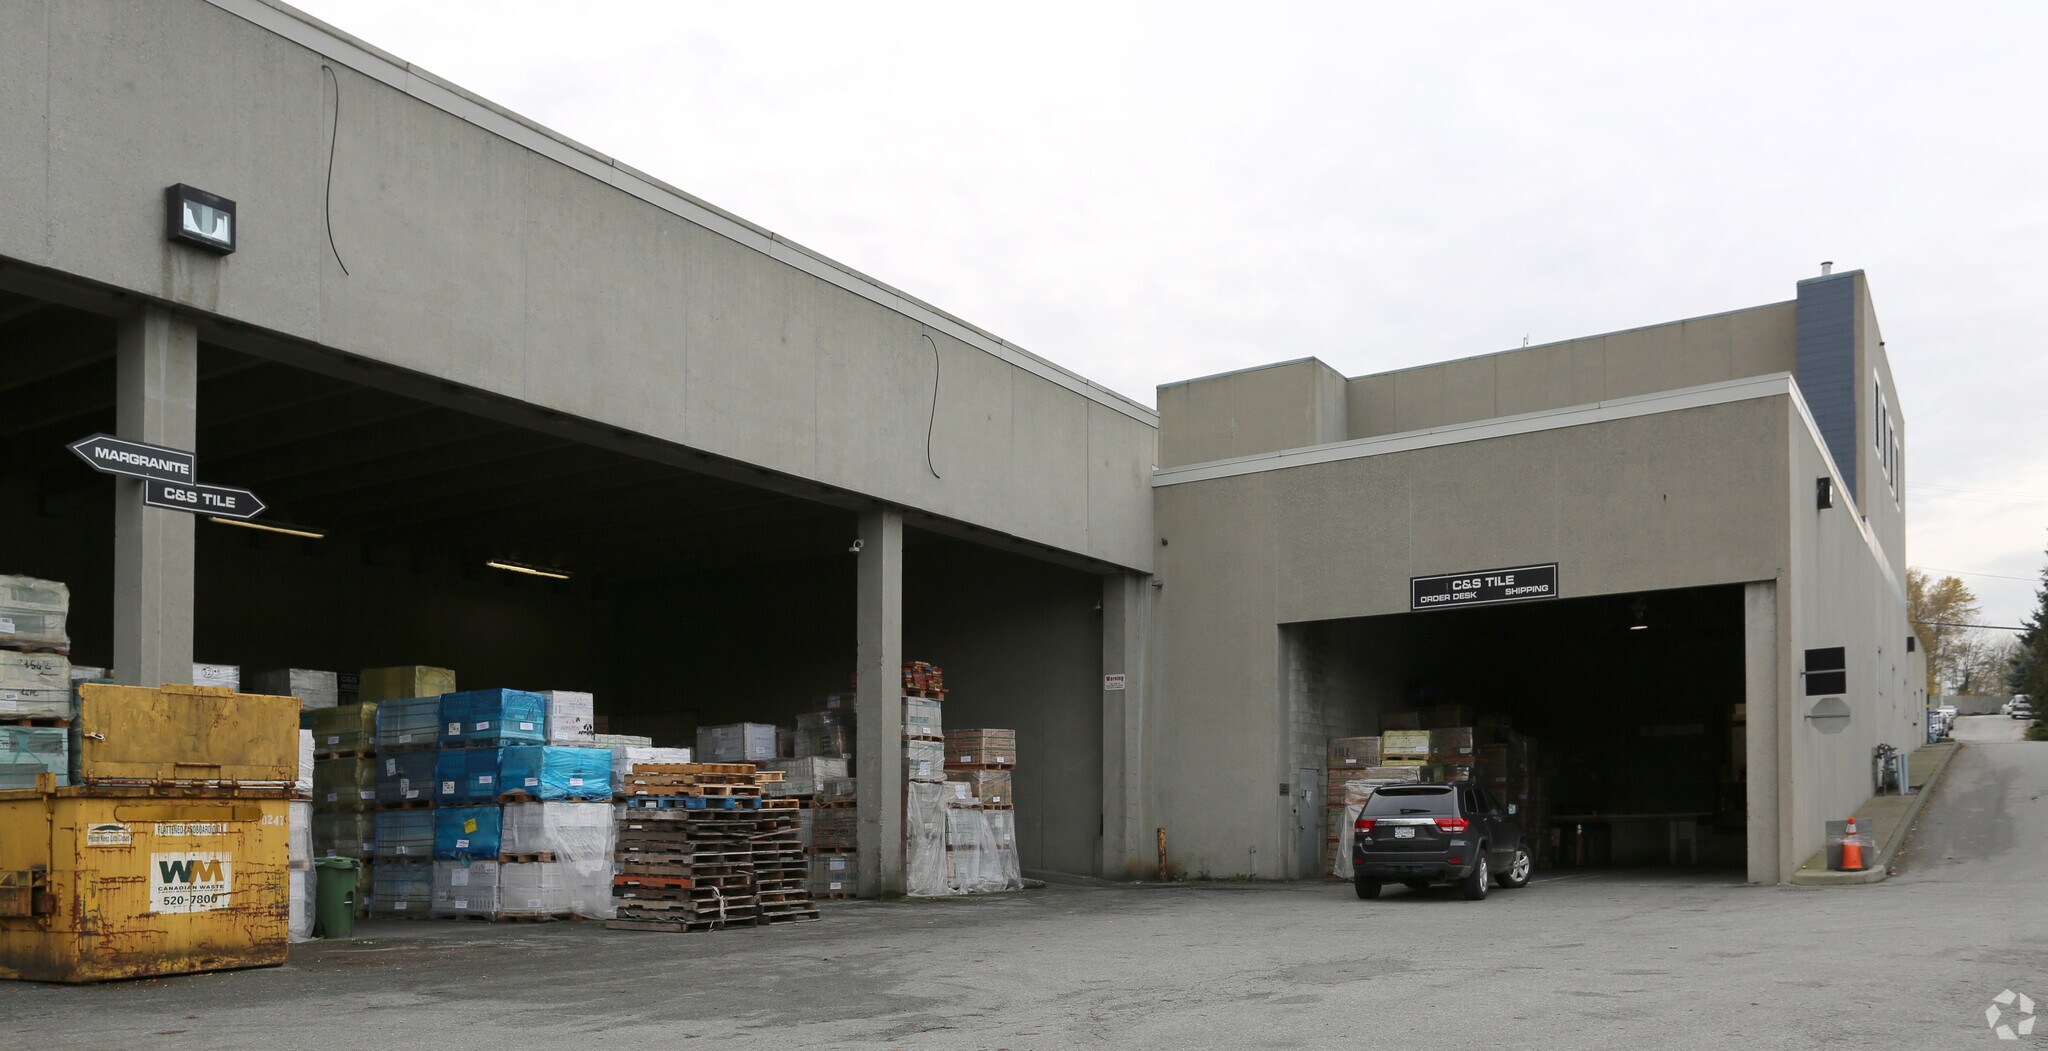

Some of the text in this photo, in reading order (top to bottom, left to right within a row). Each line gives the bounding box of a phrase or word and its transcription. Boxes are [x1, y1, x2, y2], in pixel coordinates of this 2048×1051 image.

[95, 447, 189, 475] MARGRANITE
[164, 487, 236, 508] C&S TILE
[1452, 575, 1514, 590] C&S TILE
[1420, 591, 1477, 604] ORDER DESK
[1505, 585, 1549, 596] SHIPPING
[157, 825, 183, 834] FLATTENED
[158, 859, 224, 884] WM
[163, 895, 218, 906] 520-7800
